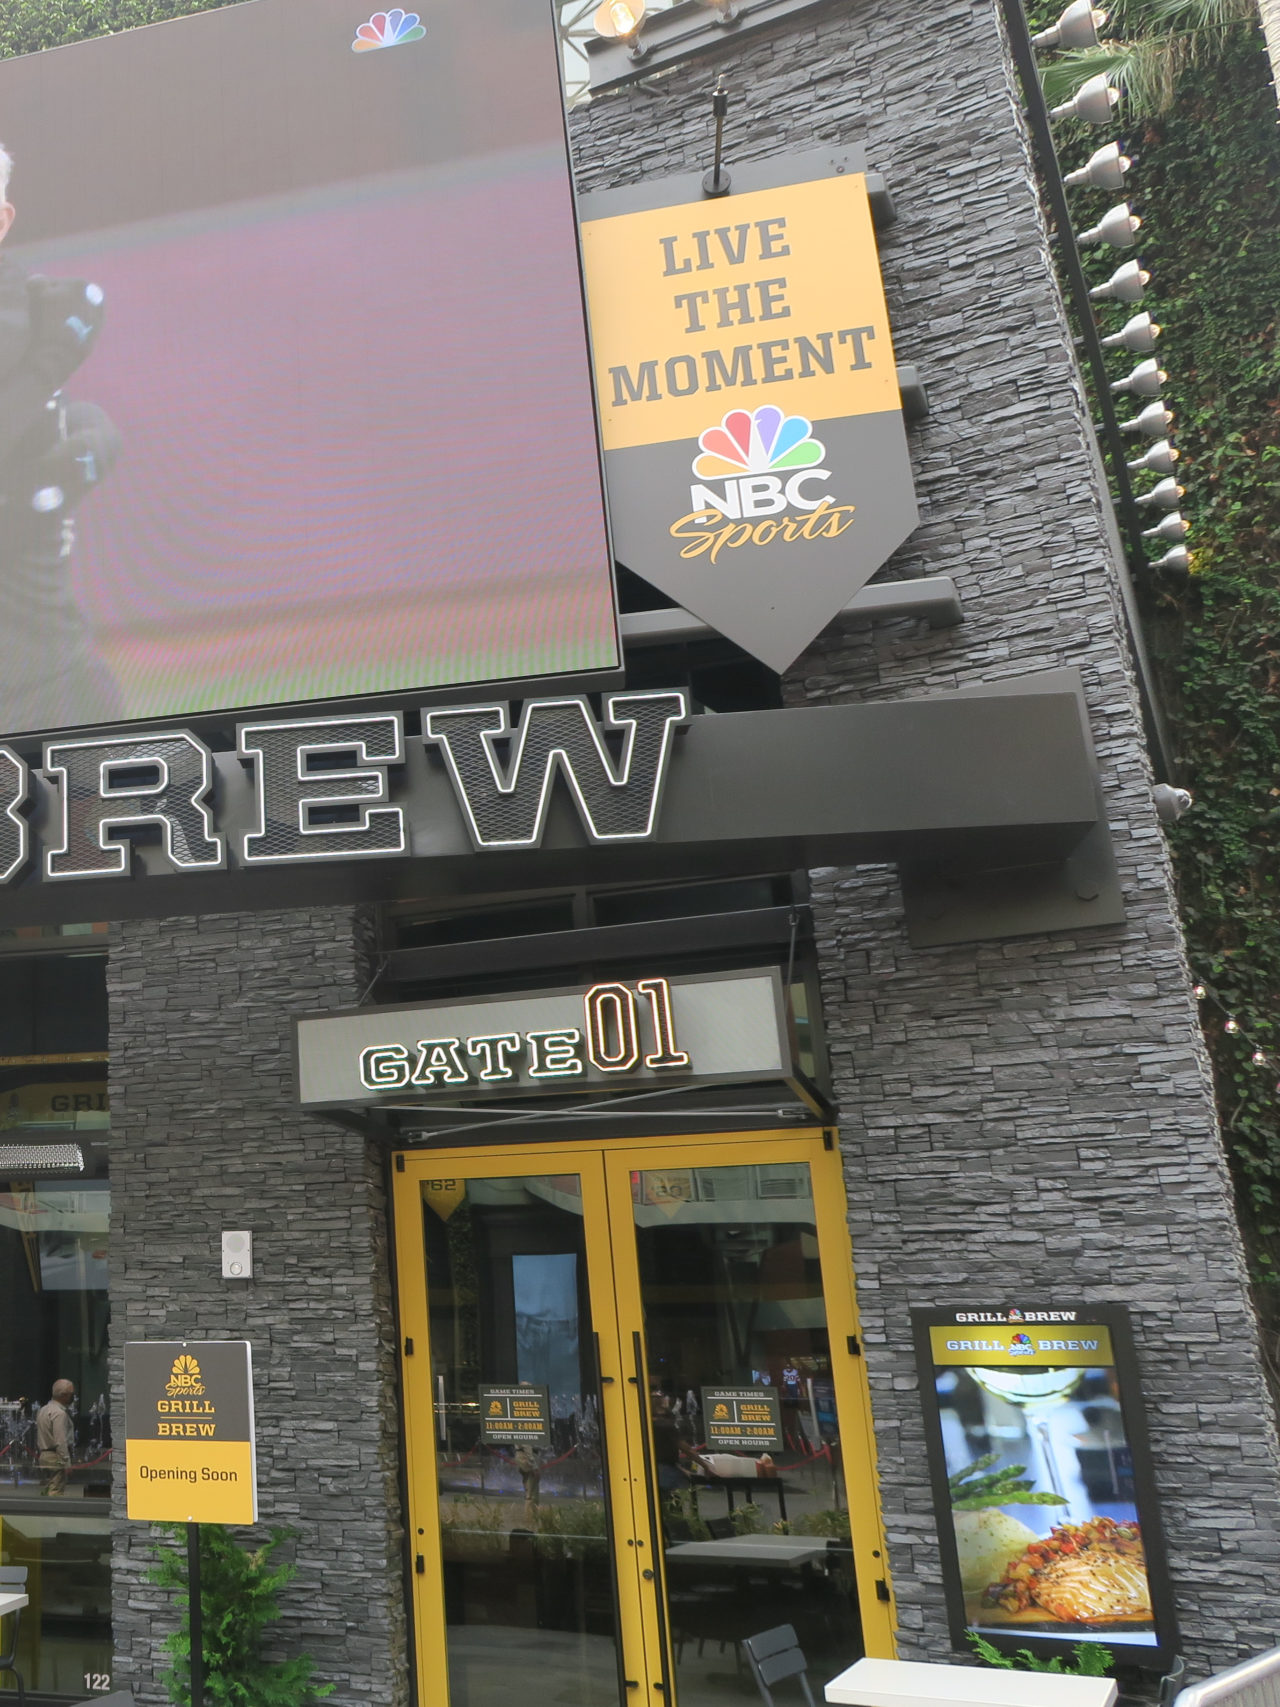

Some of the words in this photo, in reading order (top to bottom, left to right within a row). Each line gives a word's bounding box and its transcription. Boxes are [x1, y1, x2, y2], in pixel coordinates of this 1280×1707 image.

[659, 217, 791, 277] LIVE
[674, 277, 791, 333] THE
[608, 325, 875, 407] MOMENT
[690, 469, 837, 524] NBC
[669, 501, 856, 564] Sports
[358, 1028, 584, 1090] GATE
[584, 978, 690, 1072] 01
[955, 1312, 1007, 1322] GRILL
[1024, 1311, 1077, 1321] BREW
[946, 1340, 1005, 1351] GRILL
[1037, 1340, 1099, 1351] BREW
[170, 1374, 202, 1387] NBC
[165, 1382, 206, 1398] Sports
[157, 1400, 215, 1413] GRILL
[157, 1423, 216, 1437] BREW
[140, 1465, 197, 1483] Opening
[201, 1467, 238, 1482] Soon
[84, 1673, 110, 1690] 122
